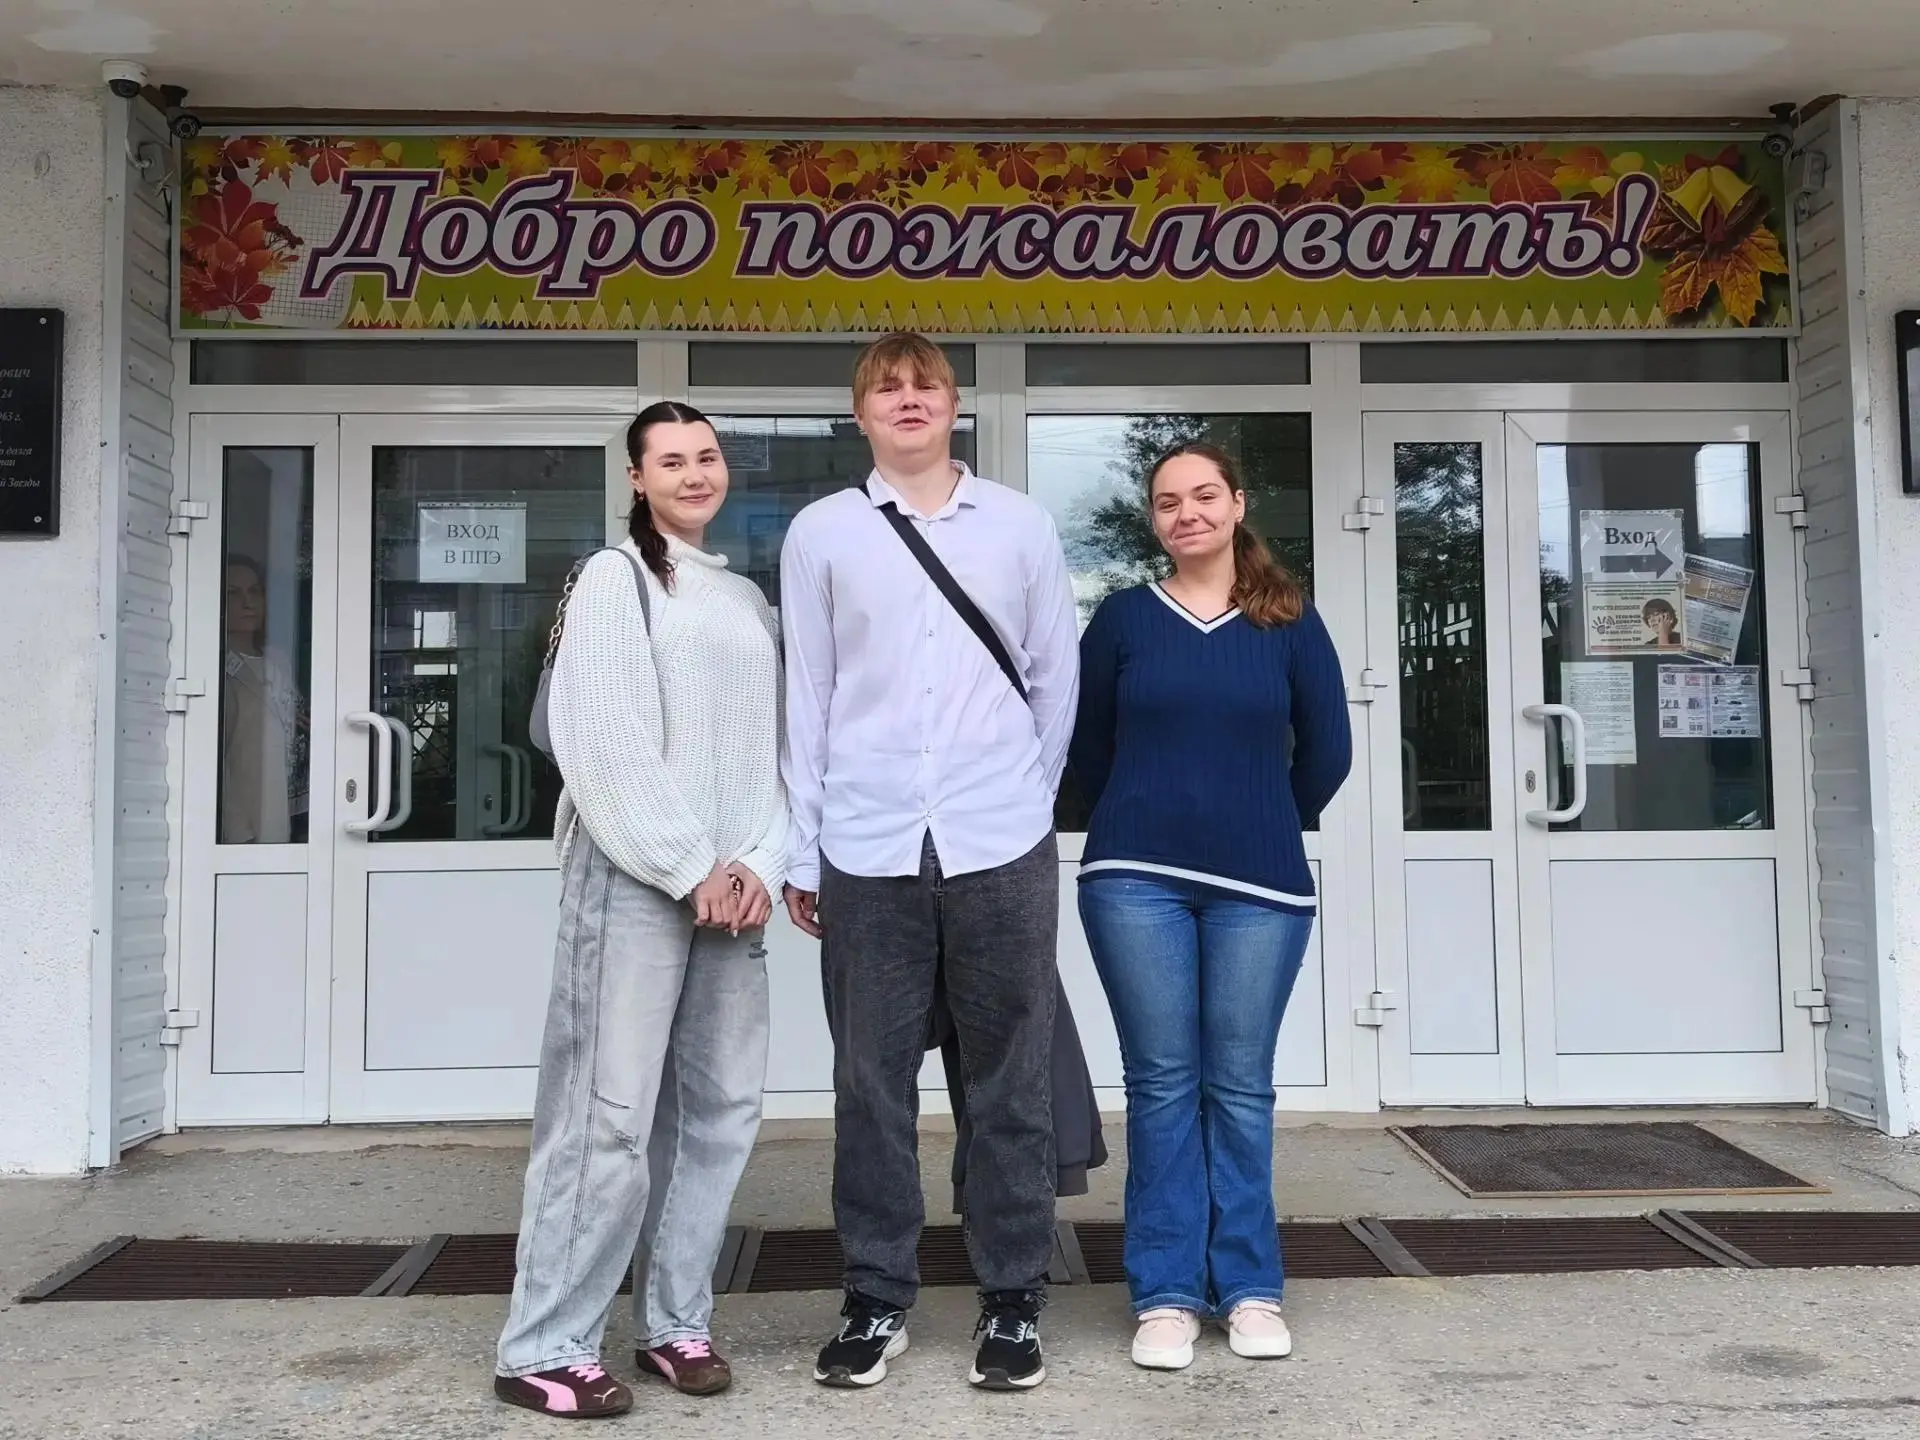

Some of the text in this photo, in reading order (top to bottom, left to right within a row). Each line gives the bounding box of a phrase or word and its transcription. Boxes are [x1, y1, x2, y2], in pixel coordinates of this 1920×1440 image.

[302, 169, 1657, 299] Добро пожаловать!
[447, 524, 500, 542] ВХОД
[1604, 527, 1658, 548] Вход
[445, 550, 501, 565] В ППЭ
